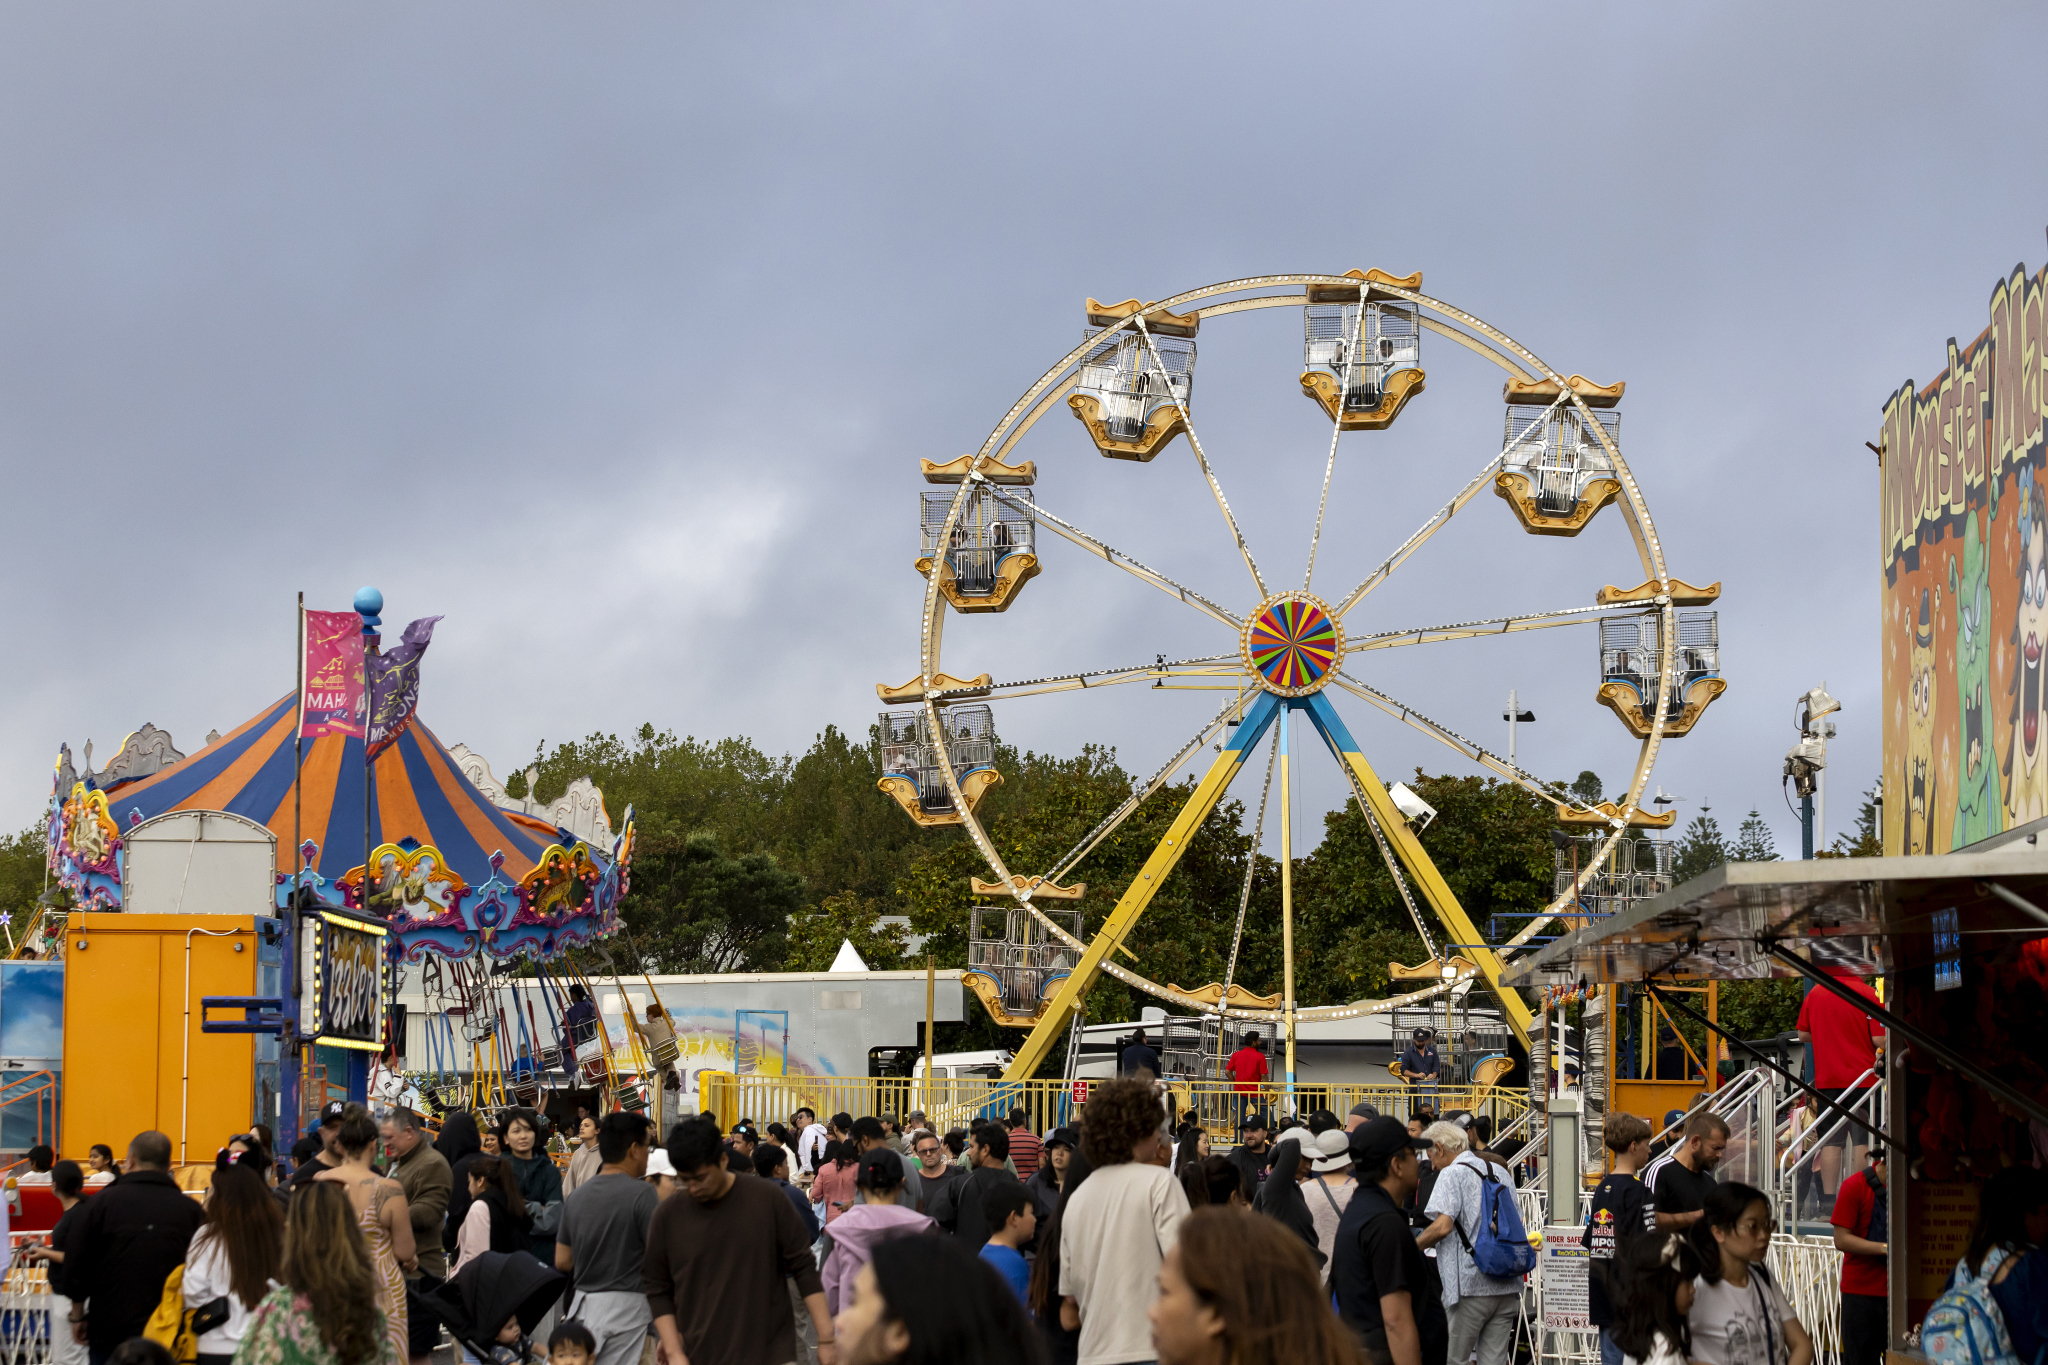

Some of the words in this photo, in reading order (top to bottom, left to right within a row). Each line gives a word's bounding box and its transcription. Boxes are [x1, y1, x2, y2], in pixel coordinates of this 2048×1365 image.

[1321, 381, 1327, 389] 3
[1883, 340, 1989, 570] Monster
[1517, 482, 1523, 490] 2
[306, 692, 347, 709] MAH
[1958, 1204, 1977, 1212] SHOT
[1592, 1225, 1602, 1236] ed
[1602, 1225, 1615, 1237] Bul
[1566, 1236, 1583, 1244] SAFE
[1591, 1237, 1616, 1247] MPOL
